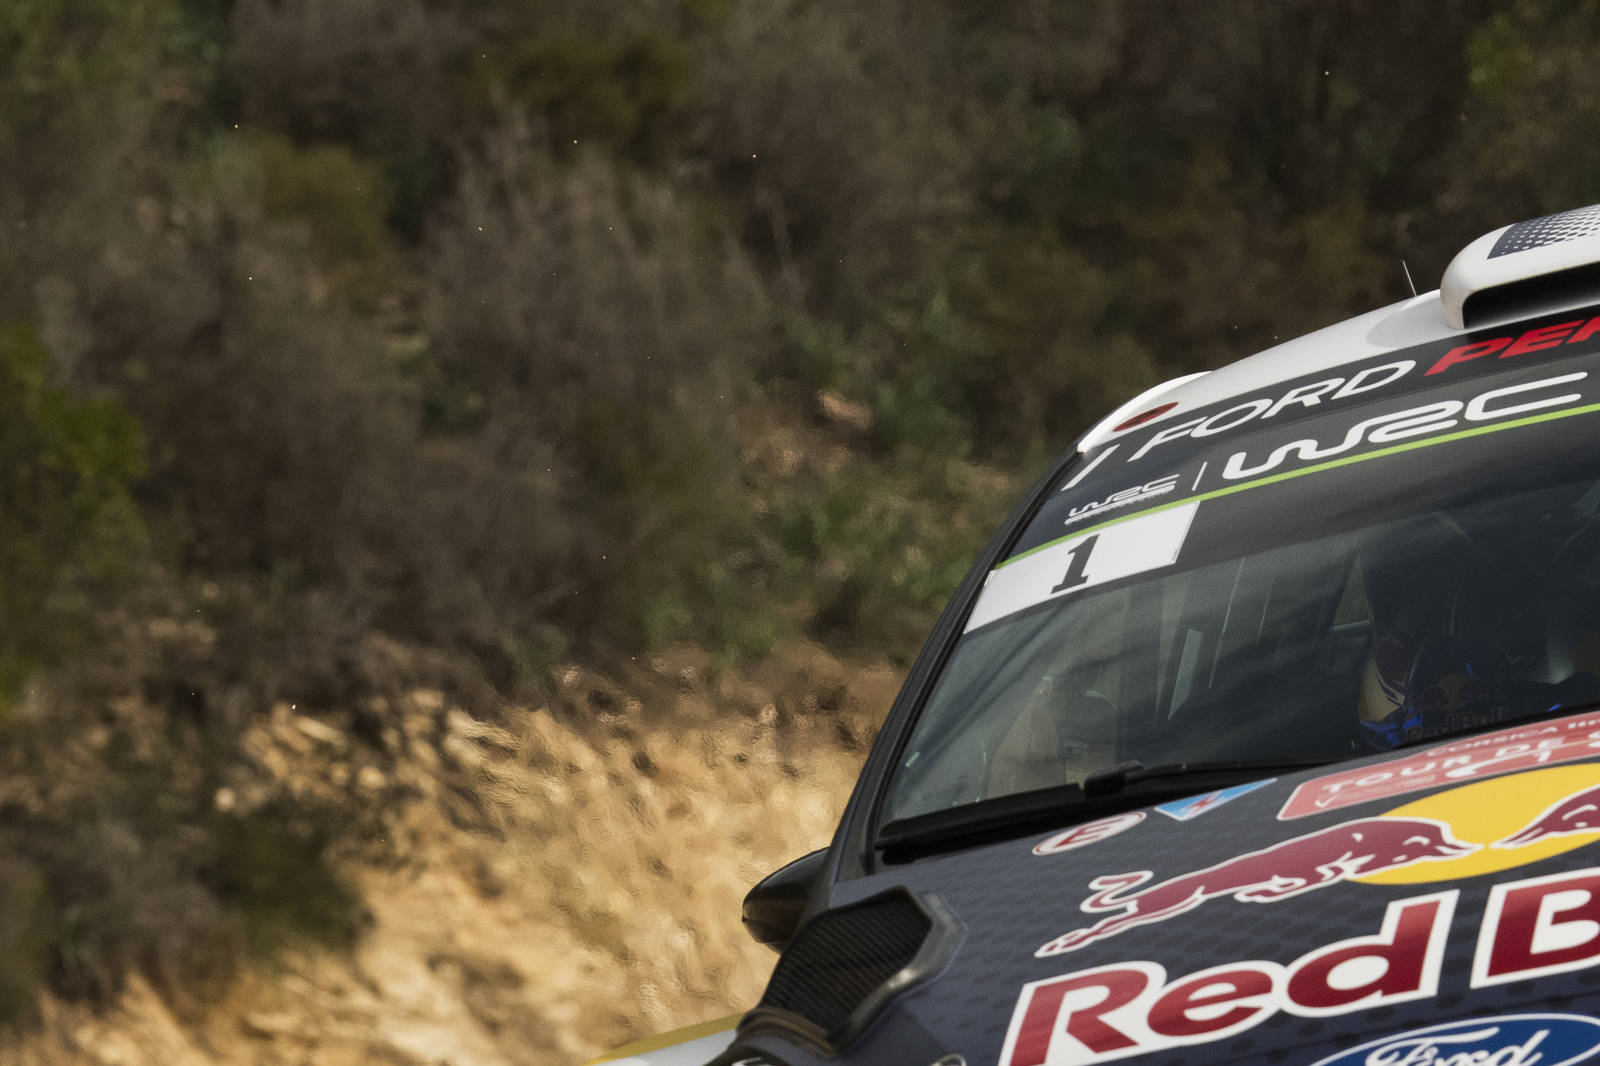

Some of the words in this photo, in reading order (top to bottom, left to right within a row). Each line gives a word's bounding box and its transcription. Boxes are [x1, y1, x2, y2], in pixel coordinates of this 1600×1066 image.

[1128, 360, 1416, 462] FORD
[1051, 534, 1100, 595] 1
[1321, 754, 1472, 793] TOUR
